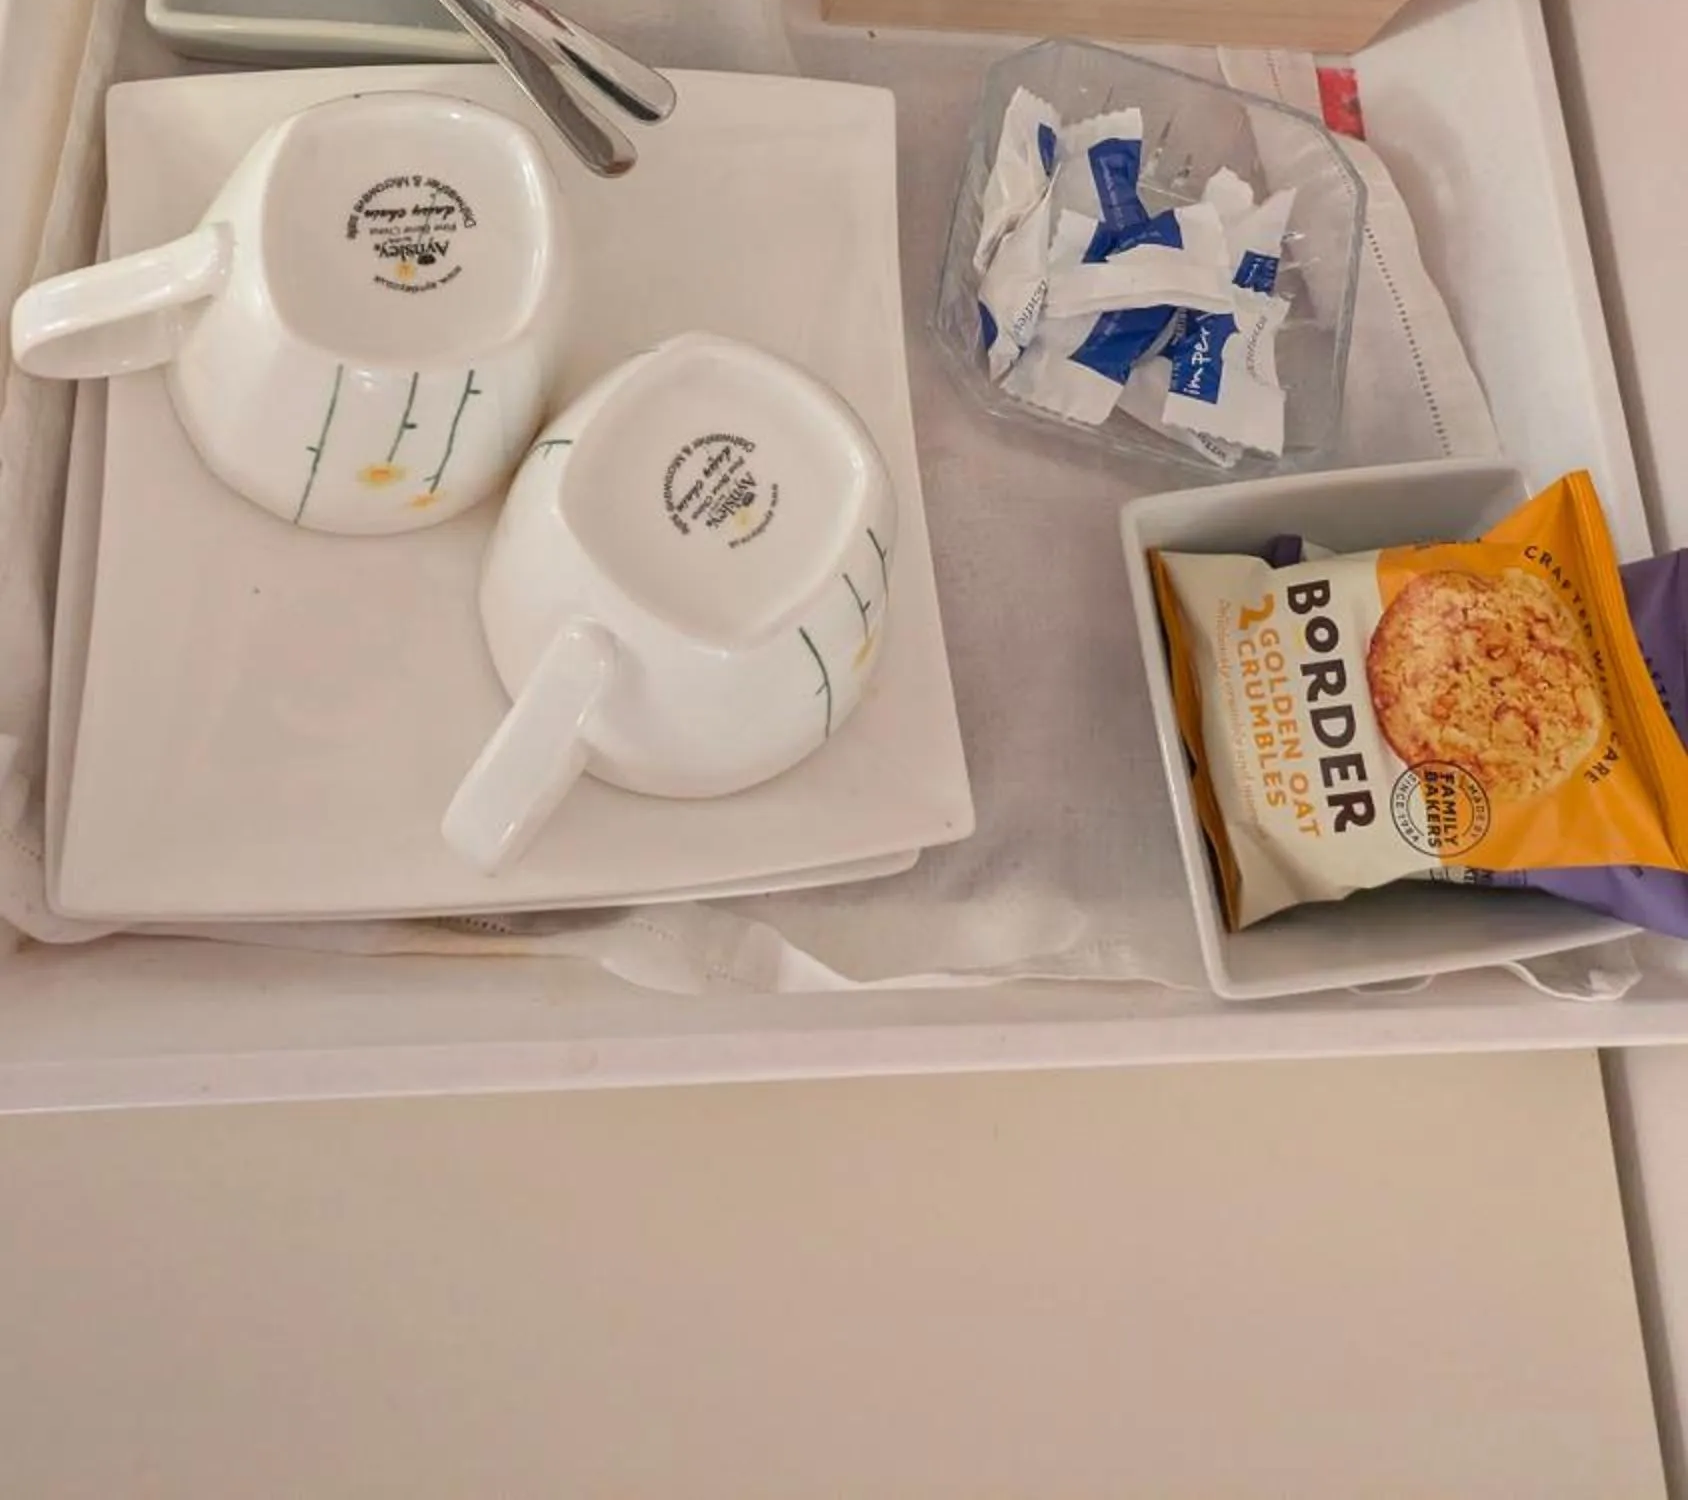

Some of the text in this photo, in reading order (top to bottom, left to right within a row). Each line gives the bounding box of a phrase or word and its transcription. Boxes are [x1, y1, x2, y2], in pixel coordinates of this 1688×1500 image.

[1238, 594, 1275, 632] 2
[1522, 544, 1595, 642] CRAFTED
[1584, 731, 1622, 786] CARE
[1237, 640, 1288, 809] CRUMBLES
[1260, 628, 1322, 839] GOLDEN OAT
[1287, 580, 1377, 834] BORDER
[1393, 773, 1419, 809] SINCE
[1422, 770, 1444, 849] BAKERS
[1439, 772, 1461, 847] FAMILY
